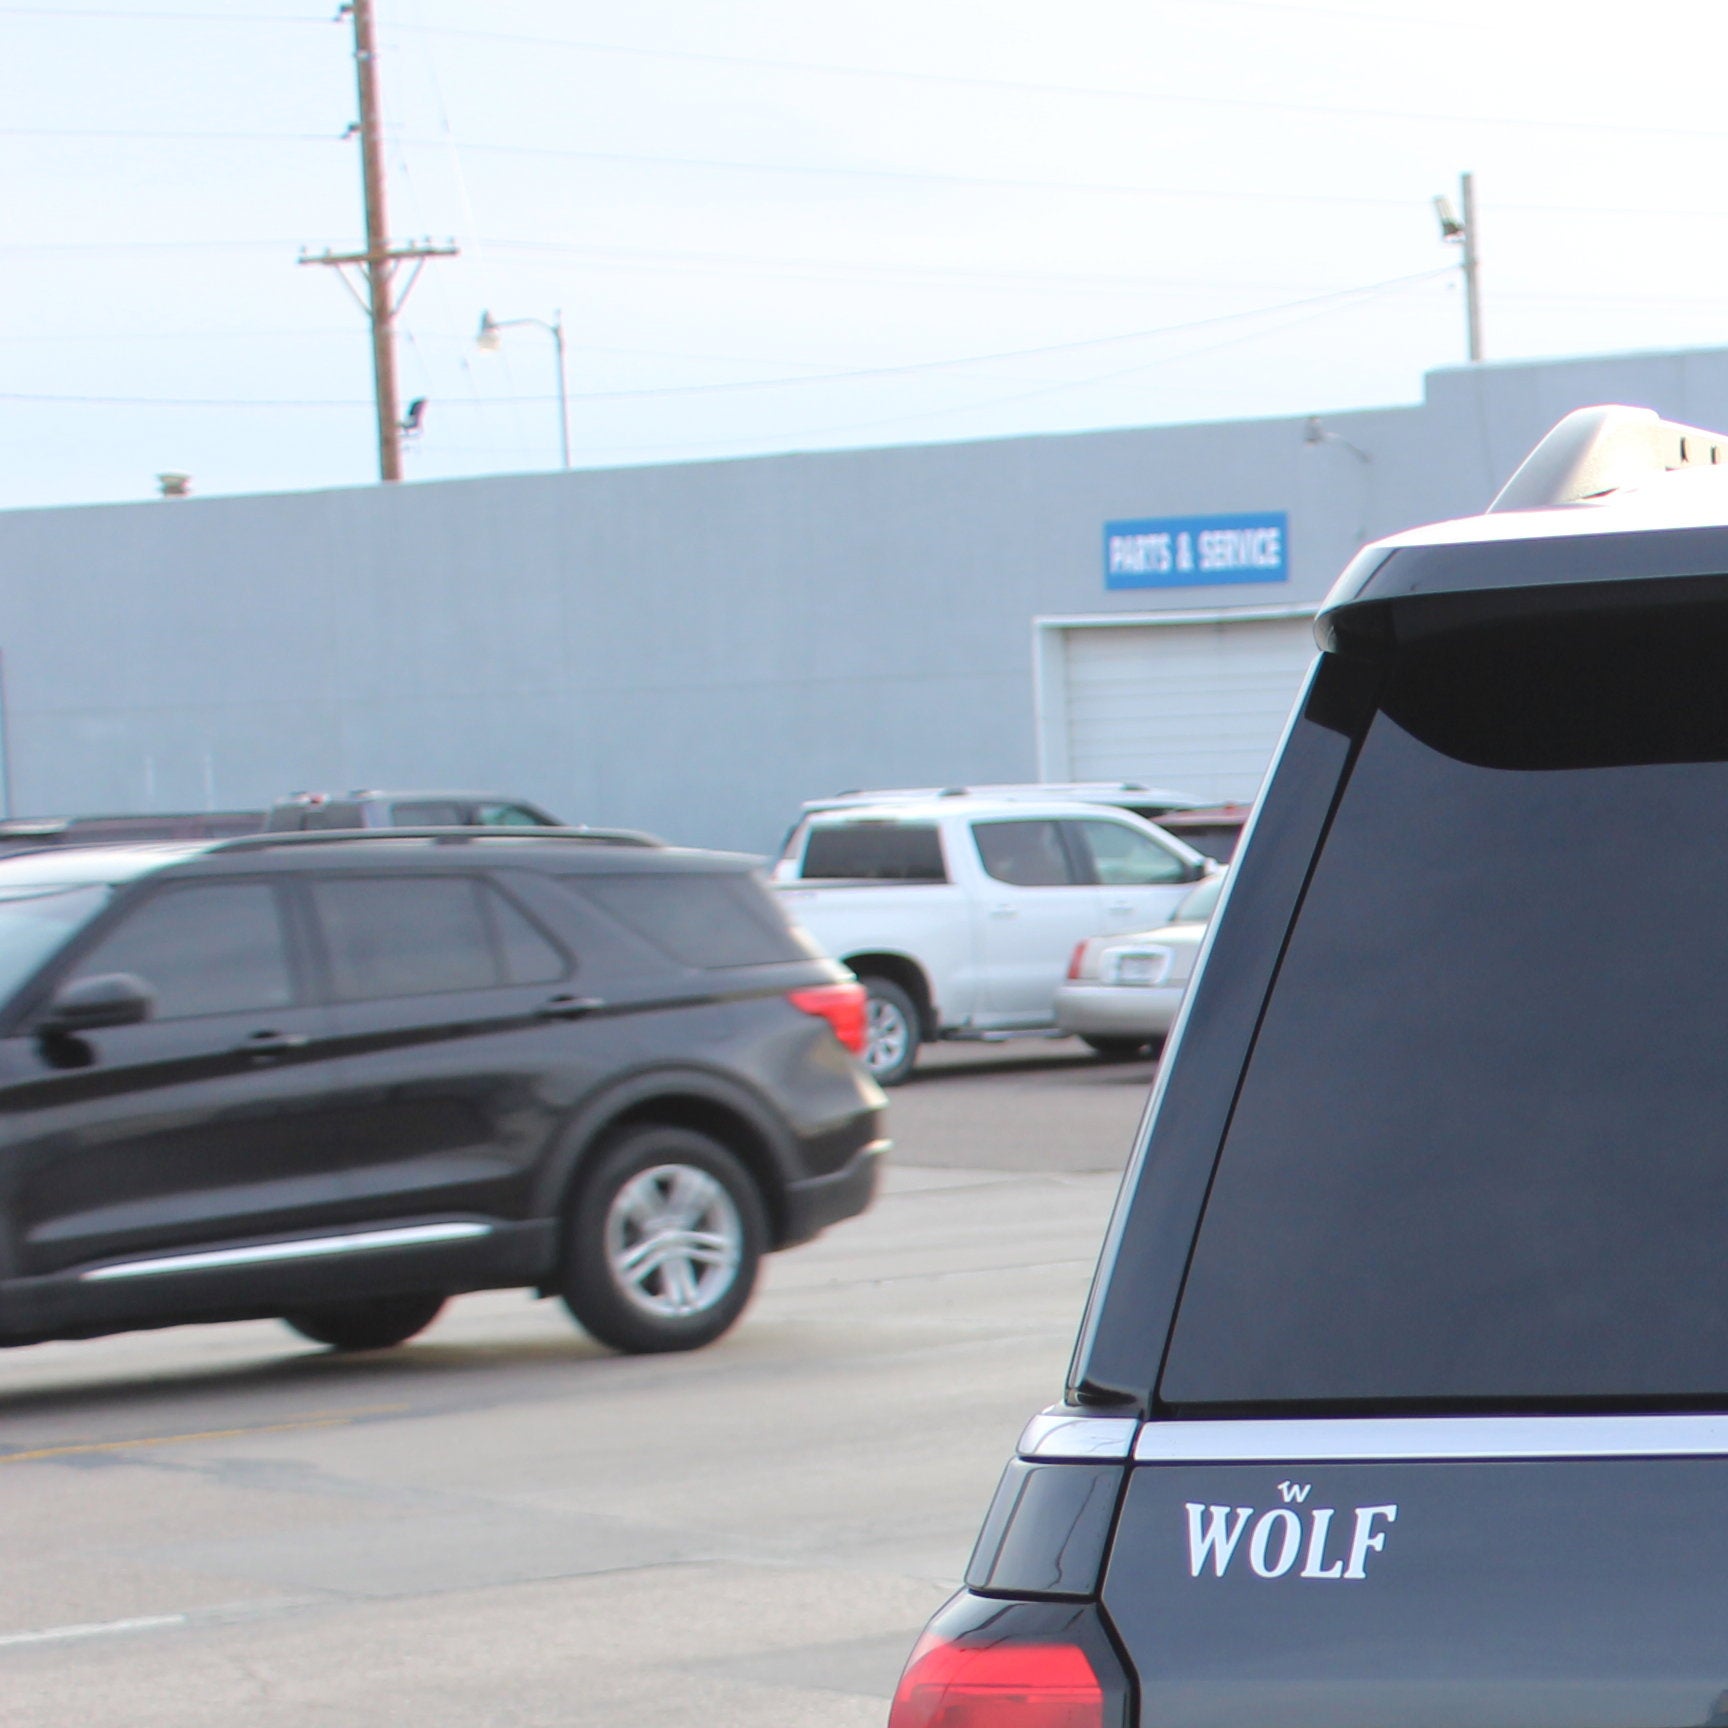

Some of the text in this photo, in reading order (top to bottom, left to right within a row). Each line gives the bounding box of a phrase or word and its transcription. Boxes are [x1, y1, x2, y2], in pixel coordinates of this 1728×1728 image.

[1109, 527, 1281, 574] PARTS & SERVICE
[1185, 1502, 1398, 1579] WOLF
